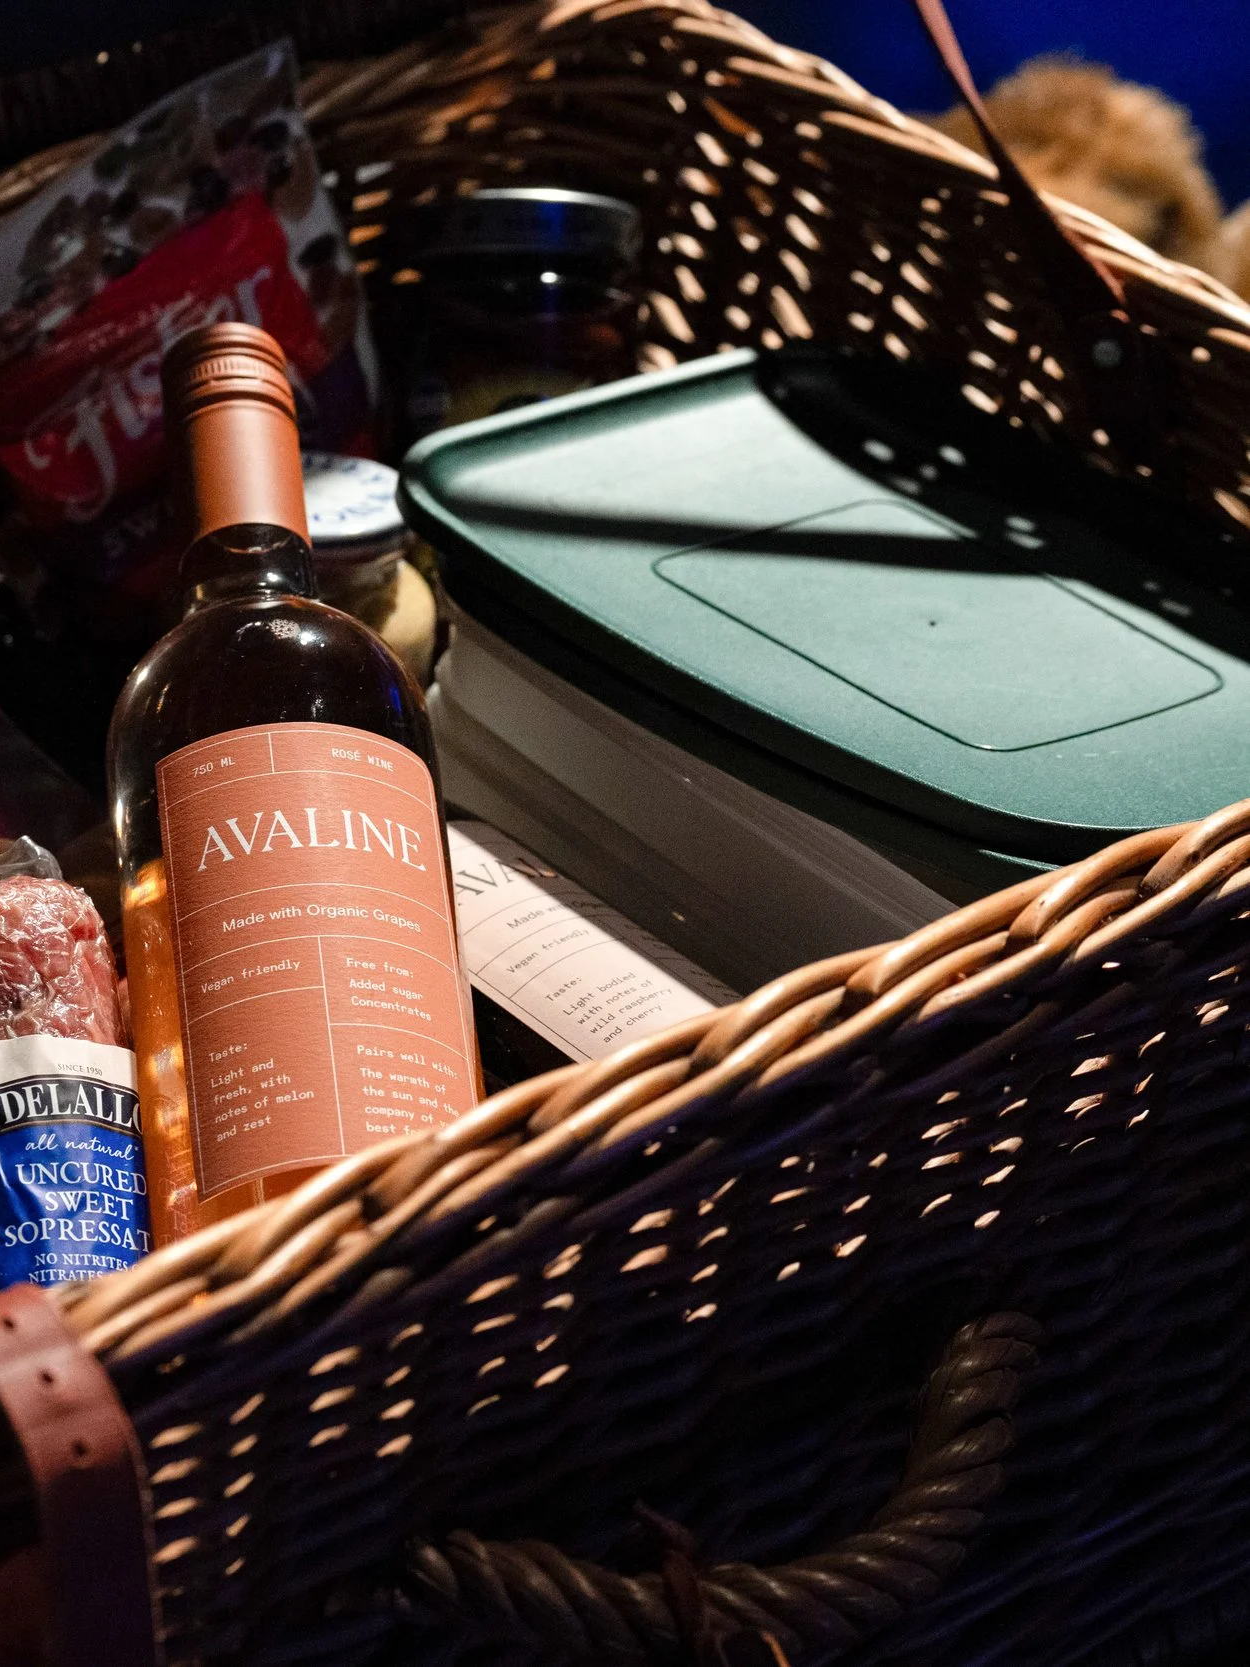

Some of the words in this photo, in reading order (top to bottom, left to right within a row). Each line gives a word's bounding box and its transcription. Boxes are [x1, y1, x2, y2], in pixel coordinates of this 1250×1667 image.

[192, 762, 215, 777] 750
[220, 756, 236, 768] ML
[331, 747, 361, 762] ROSÉ
[367, 755, 395, 772] WINE
[197, 807, 427, 872] AVALINE
[222, 910, 265, 933] Made
[269, 905, 303, 922] with
[306, 904, 369, 925] Organic
[373, 909, 422, 934] Grapes
[506, 909, 545, 930] Made
[506, 950, 540, 975] Vegan
[541, 927, 590, 951] friendly
[200, 975, 235, 995] Vegan
[241, 958, 302, 981] friendly
[346, 958, 377, 971] Free
[383, 962, 416, 979] from:
[349, 978, 387, 993] Added
[392, 986, 424, 1003] sugar
[545, 976, 583, 1003] Taste:
[562, 989, 596, 1017] Light
[600, 971, 637, 993] bodied
[577, 1006, 603, 1026] with
[606, 987, 637, 1008] notes
[640, 979, 654, 990] of
[351, 996, 433, 1022] Concentrates
[589, 1013, 616, 1035] wild
[618, 987, 673, 1015] raspberry
[603, 1026, 624, 1044] and
[626, 1004, 663, 1028] cherry
[209, 1042, 249, 1064] Taste:
[357, 1045, 394, 1058] Pairs
[400, 1052, 427, 1066] well
[432, 1062, 459, 1079] with:
[57, 1063, 84, 1074] SINCE
[86, 1067, 103, 1077] 1950
[210, 1067, 246, 1089] Light
[252, 1058, 276, 1073] and
[360, 1067, 383, 1079] The
[389, 1073, 430, 1088] warmth
[435, 1084, 447, 1094] of
[213, 1085, 253, 1105] fresh,
[260, 1073, 292, 1089] with
[362, 1085, 385, 1097] the
[392, 1091, 414, 1101] sun
[419, 1096, 438, 1109] and
[443, 1103, 460, 1118] the
[214, 1105, 250, 1124] notes
[254, 1098, 269, 1111] of
[276, 1092, 316, 1104] melon
[365, 1106, 415, 1121] company
[421, 1114, 434, 1125] of
[216, 1126, 240, 1142] and
[244, 1115, 273, 1135] zest
[366, 1121, 396, 1135] best
[25, 1133, 59, 1151] all
[15, 1161, 147, 1196] UNCURED
[45, 1191, 134, 1221] SWEET
[35, 1253, 58, 1267] NO
[62, 1253, 129, 1273] NITRITES
[29, 1271, 104, 1284] NITRATES
